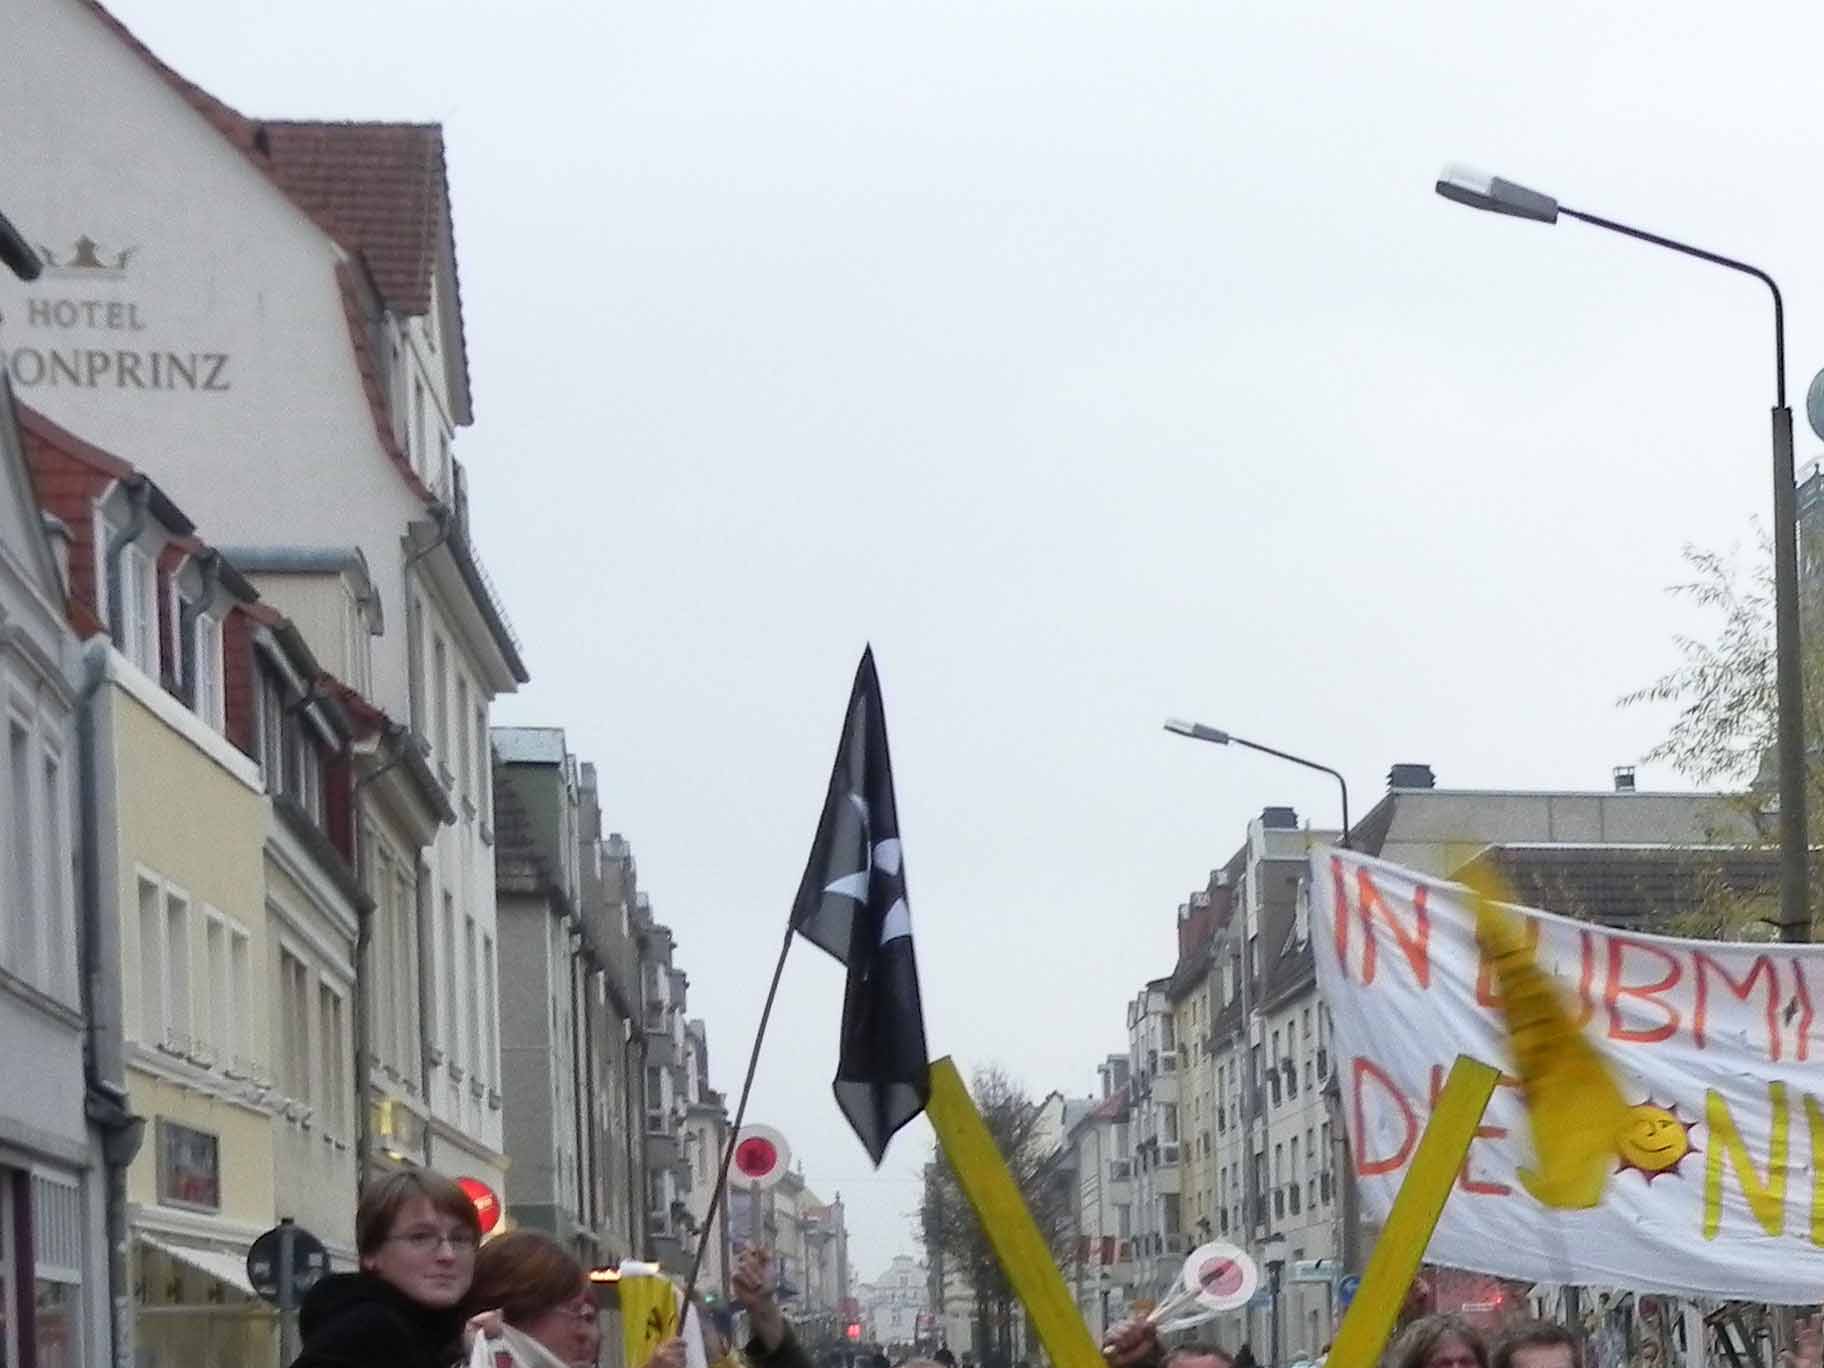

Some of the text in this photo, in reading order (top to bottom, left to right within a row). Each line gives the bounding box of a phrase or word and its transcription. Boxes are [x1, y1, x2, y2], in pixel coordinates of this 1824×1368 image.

[28, 298, 146, 331] HOTEL
[0, 348, 231, 391] ONPRINZ
[1330, 855, 1430, 990] IN
